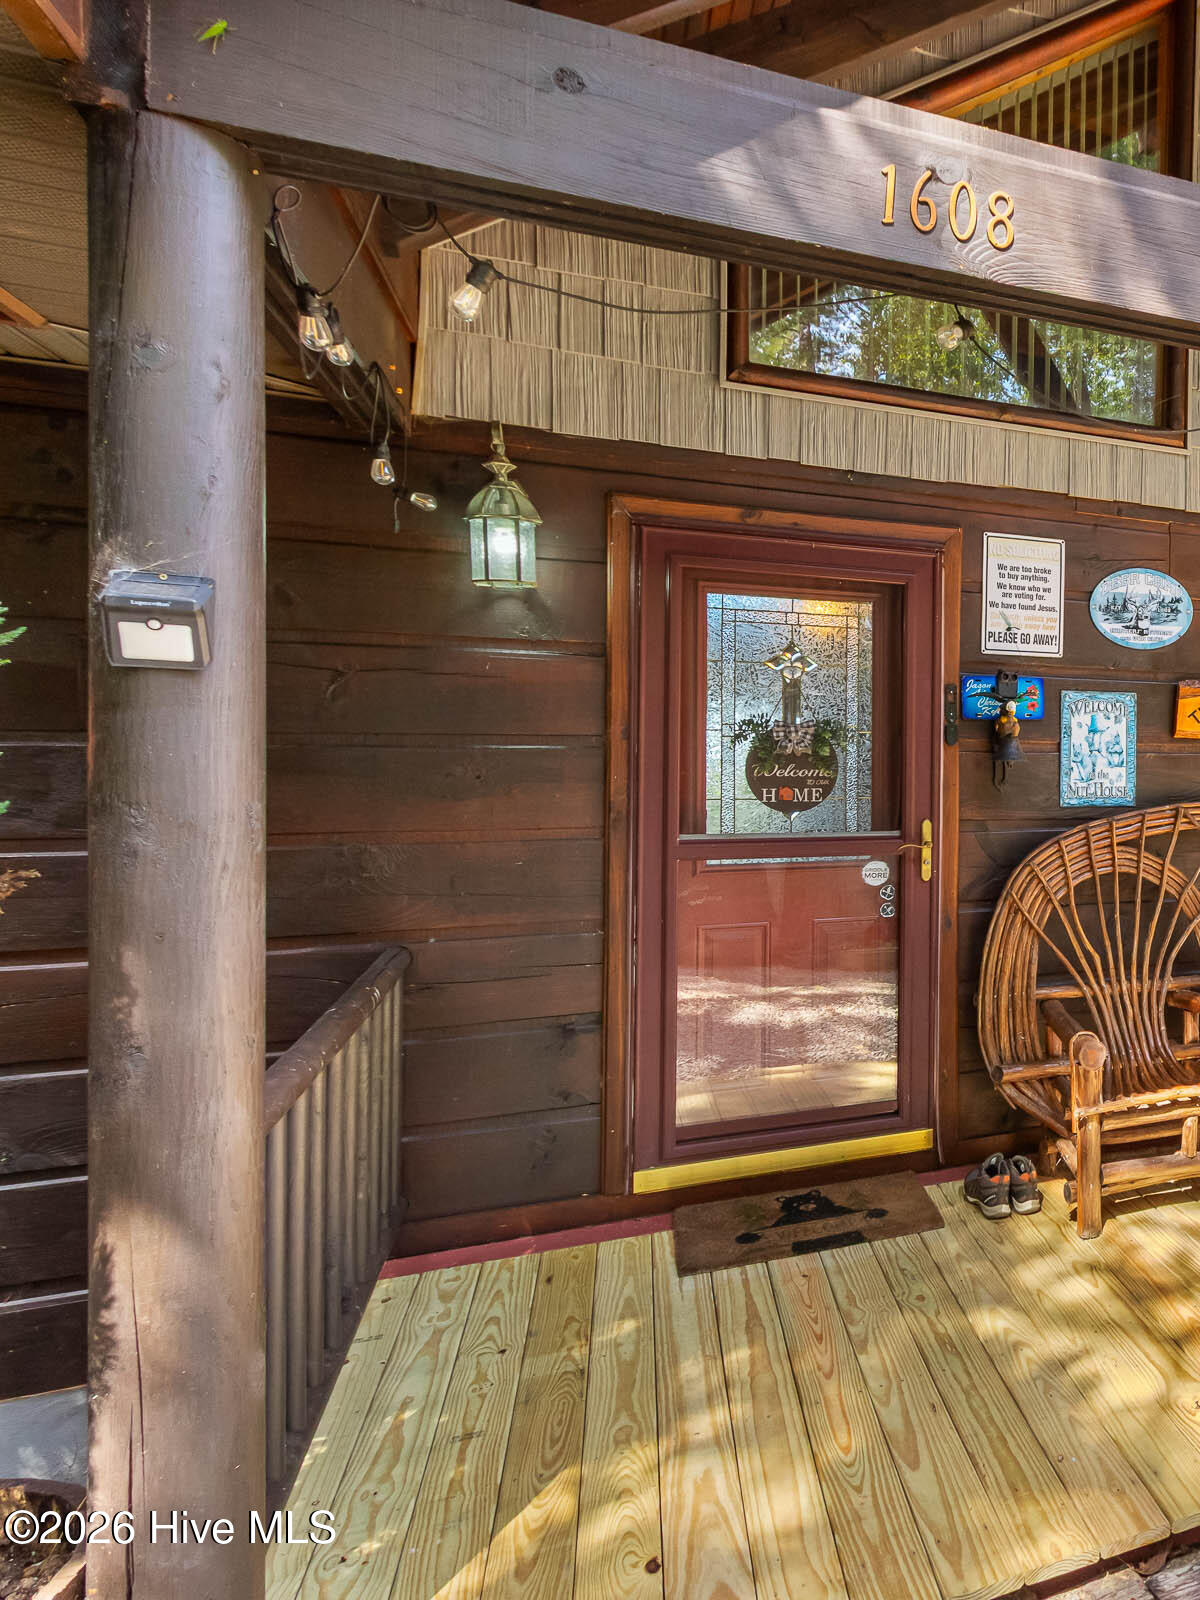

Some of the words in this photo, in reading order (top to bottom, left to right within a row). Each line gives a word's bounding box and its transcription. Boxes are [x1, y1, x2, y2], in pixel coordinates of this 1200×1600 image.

[881, 164, 1014, 250] 1608
[997, 563, 1008, 572] We
[1034, 567, 1052, 575] broke
[1008, 572, 1019, 581] buy
[1021, 574, 1050, 584] anything.
[997, 582, 1007, 590] We
[1009, 583, 1026, 591] know
[1014, 592, 1034, 601] voting
[1036, 593, 1046, 601] for.
[989, 601, 999, 609] We
[1001, 602, 1016, 610] have
[1019, 603, 1036, 611] found
[1038, 604, 1058, 612] Jesus.
[988, 631, 1018, 643] PLEASE
[1020, 633, 1031, 645] GO
[1033, 634, 1057, 646] AWAY!
[965, 679, 992, 692] Jason
